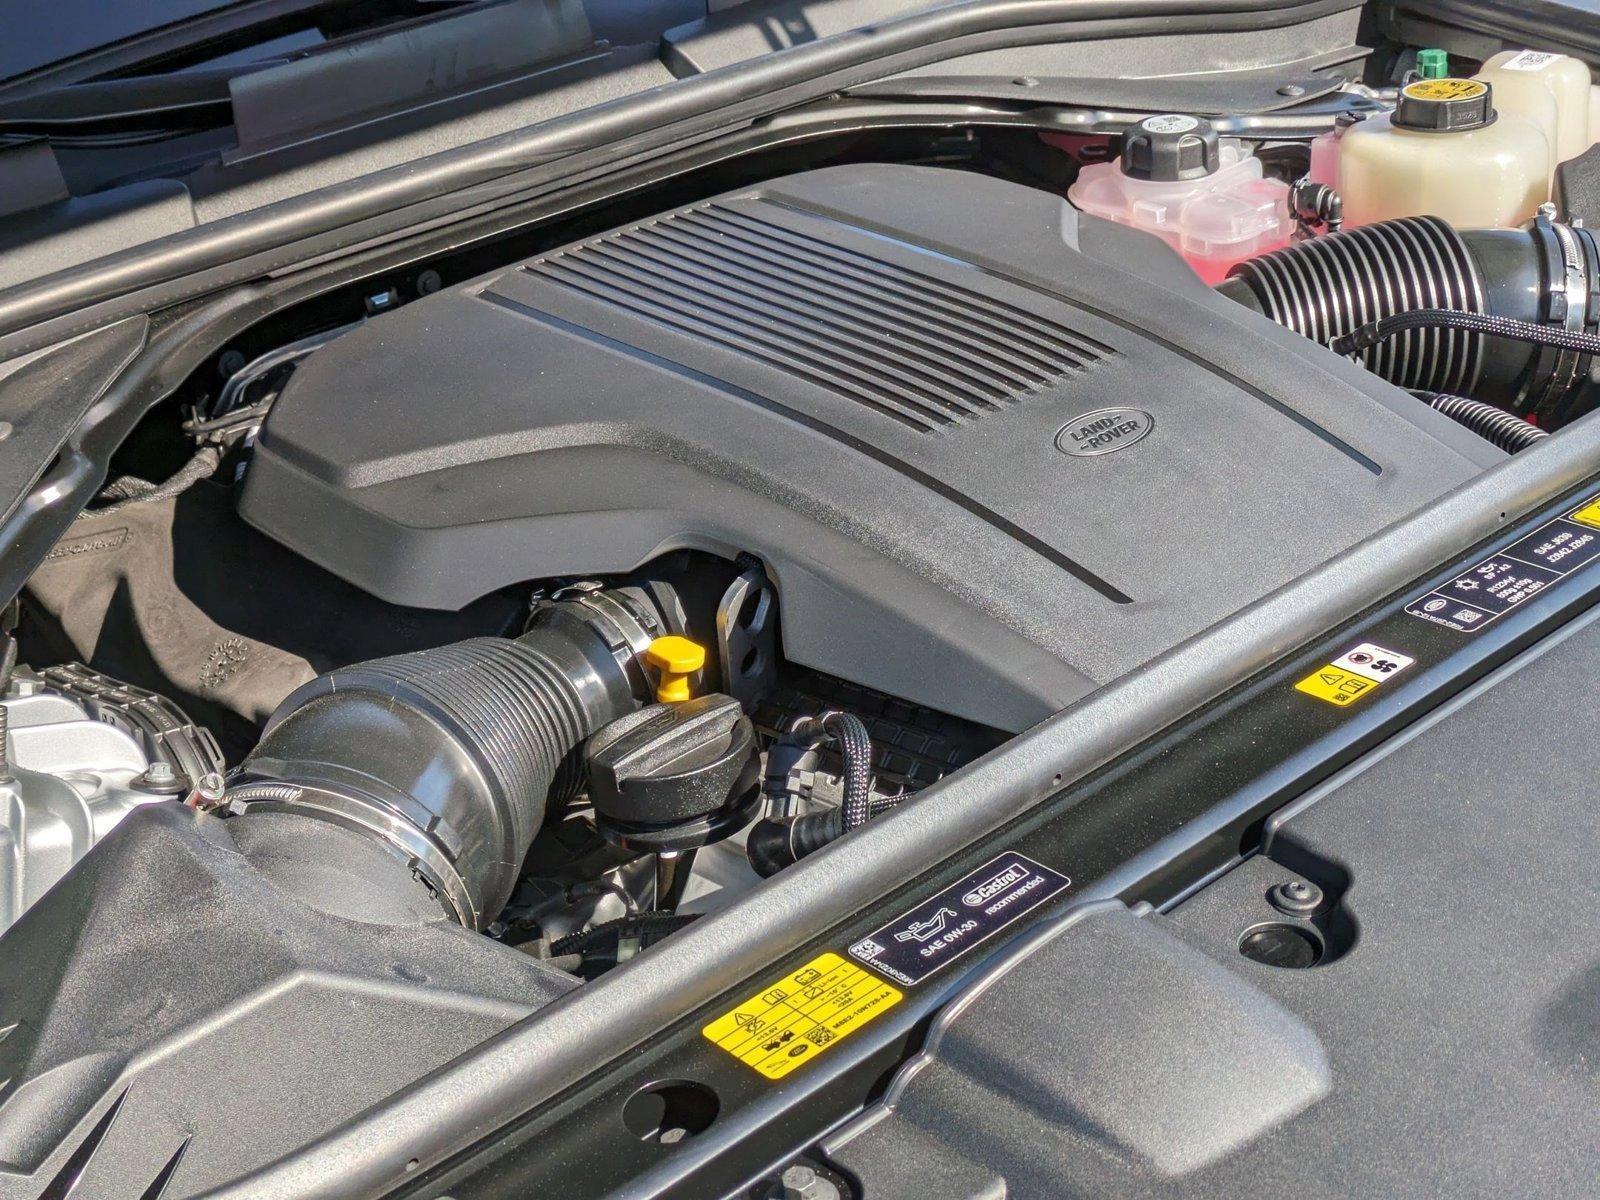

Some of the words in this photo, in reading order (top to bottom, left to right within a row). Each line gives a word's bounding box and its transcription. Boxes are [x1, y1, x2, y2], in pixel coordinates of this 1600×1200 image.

[978, 868, 1022, 899] Castrol
[984, 875, 1045, 916] recommended
[920, 939, 947, 957] SAE
[943, 919, 979, 945] 0W-30
